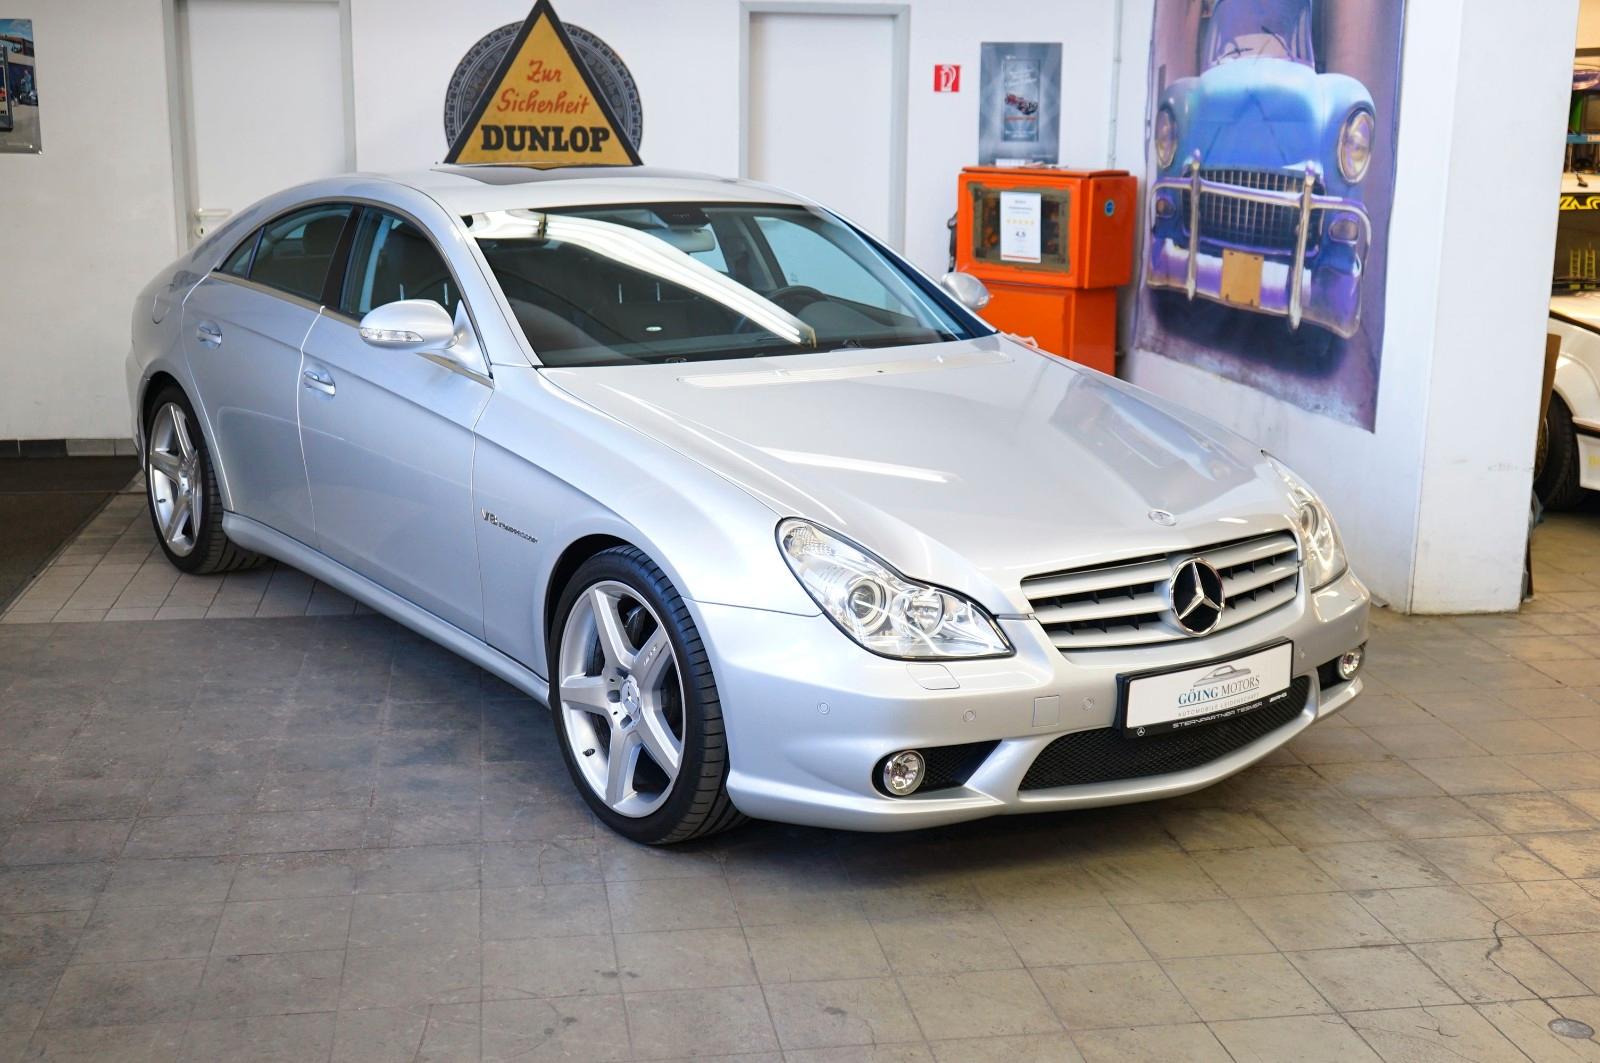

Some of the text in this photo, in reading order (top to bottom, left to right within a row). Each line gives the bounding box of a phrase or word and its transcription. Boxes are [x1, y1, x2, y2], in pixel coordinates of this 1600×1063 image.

[527, 59, 562, 83] Zur
[497, 88, 590, 114] Sicherheit
[481, 124, 610, 153] DUNLOP
[1178, 676, 1260, 705] GÖING MOTORS
